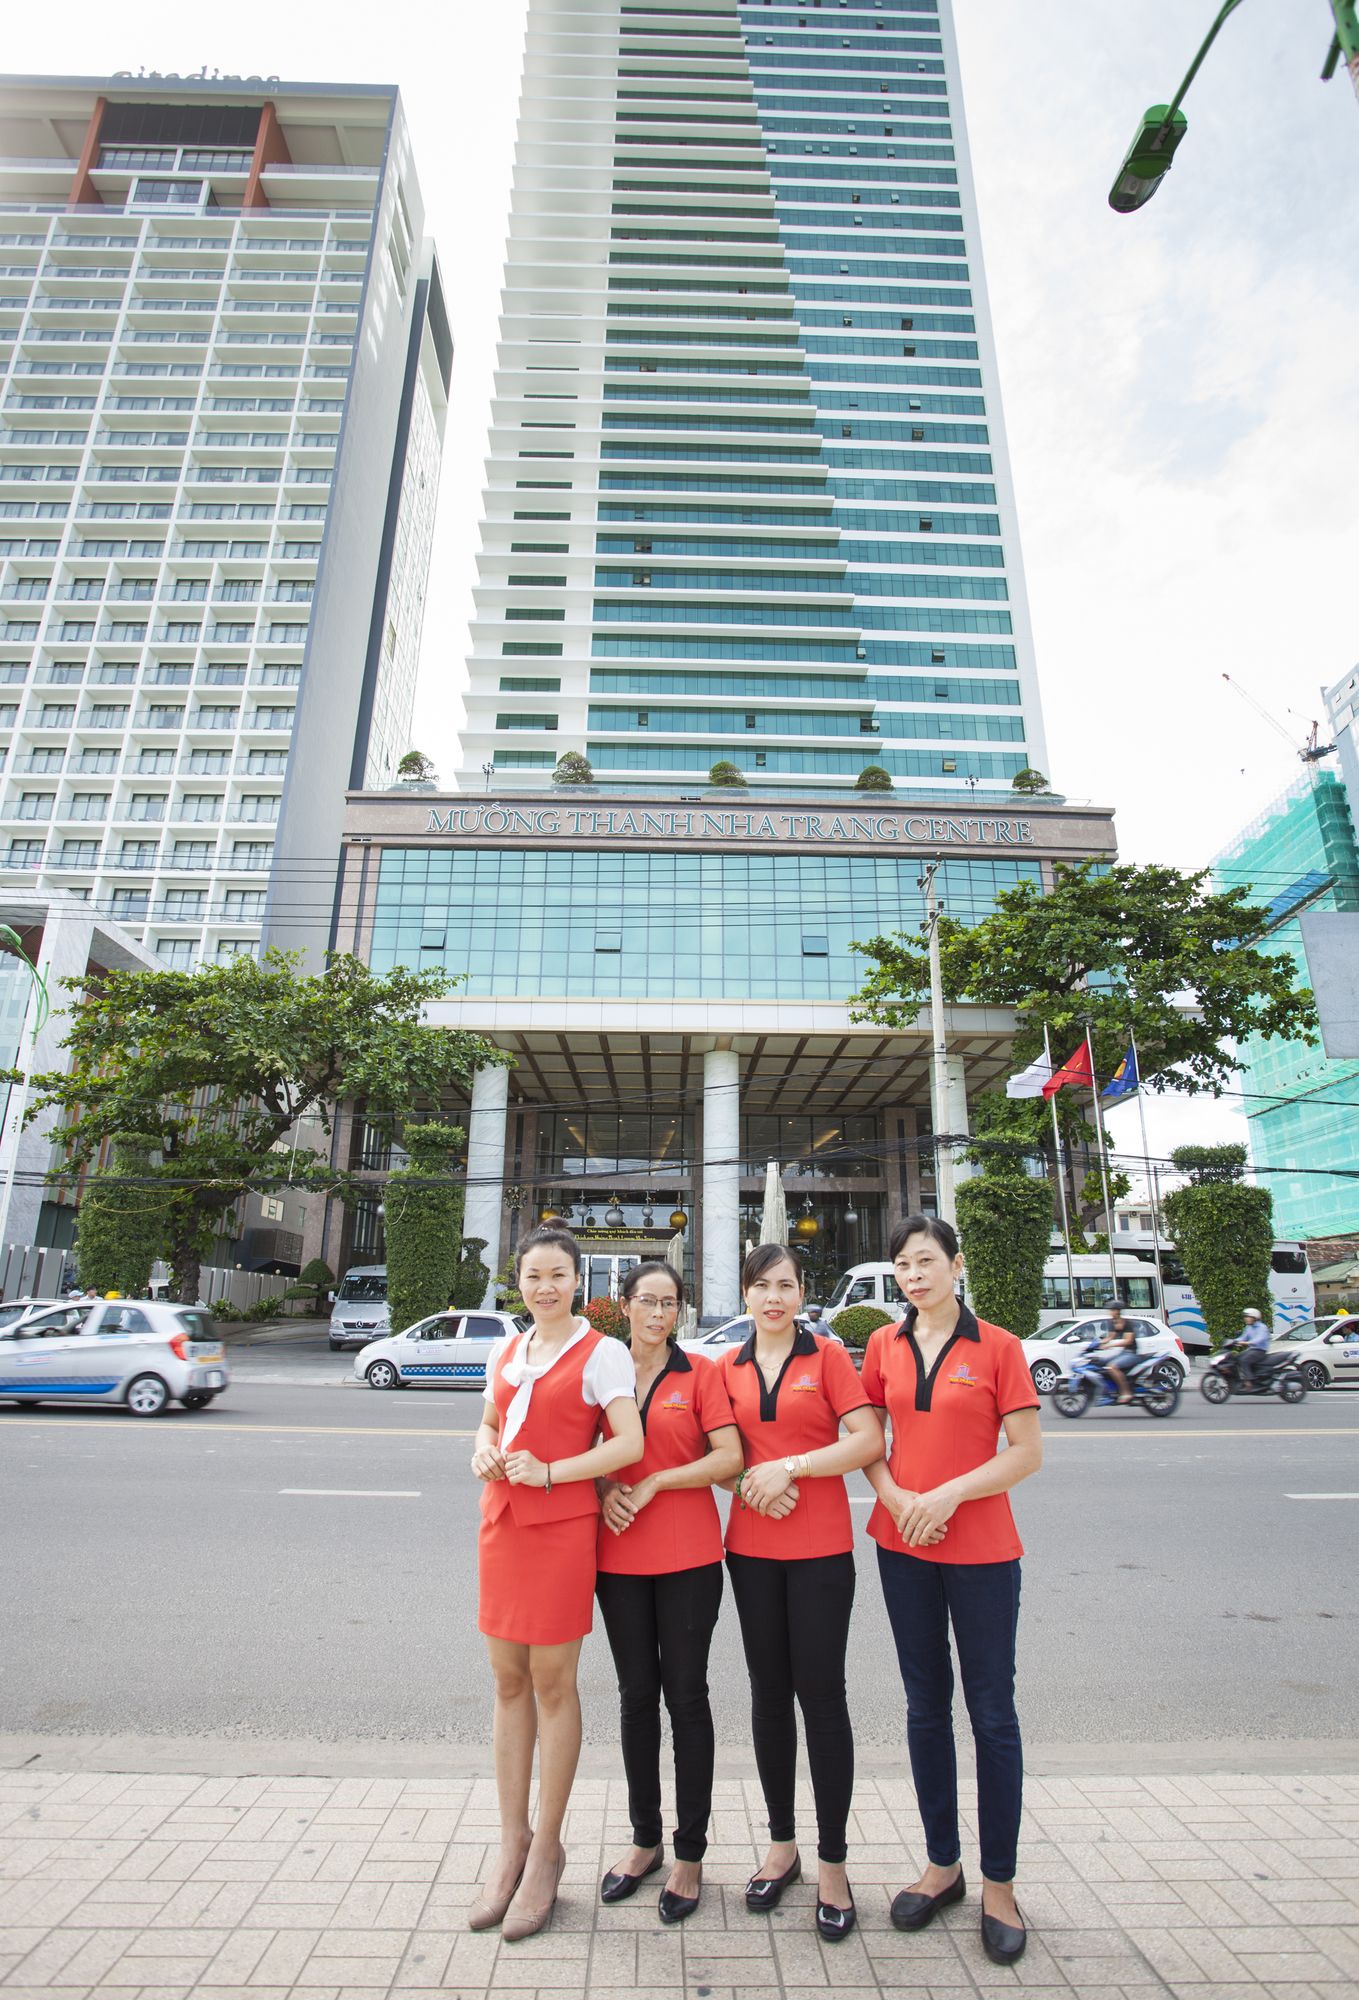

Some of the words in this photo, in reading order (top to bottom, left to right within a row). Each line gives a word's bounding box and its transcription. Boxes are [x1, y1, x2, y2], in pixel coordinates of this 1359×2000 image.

[426, 802, 560, 833] MƯỜNG
[566, 810, 696, 836] THANH
[702, 813, 779, 838] NHA
[780, 815, 900, 841] TRANG
[903, 817, 1035, 844] CENTRE
